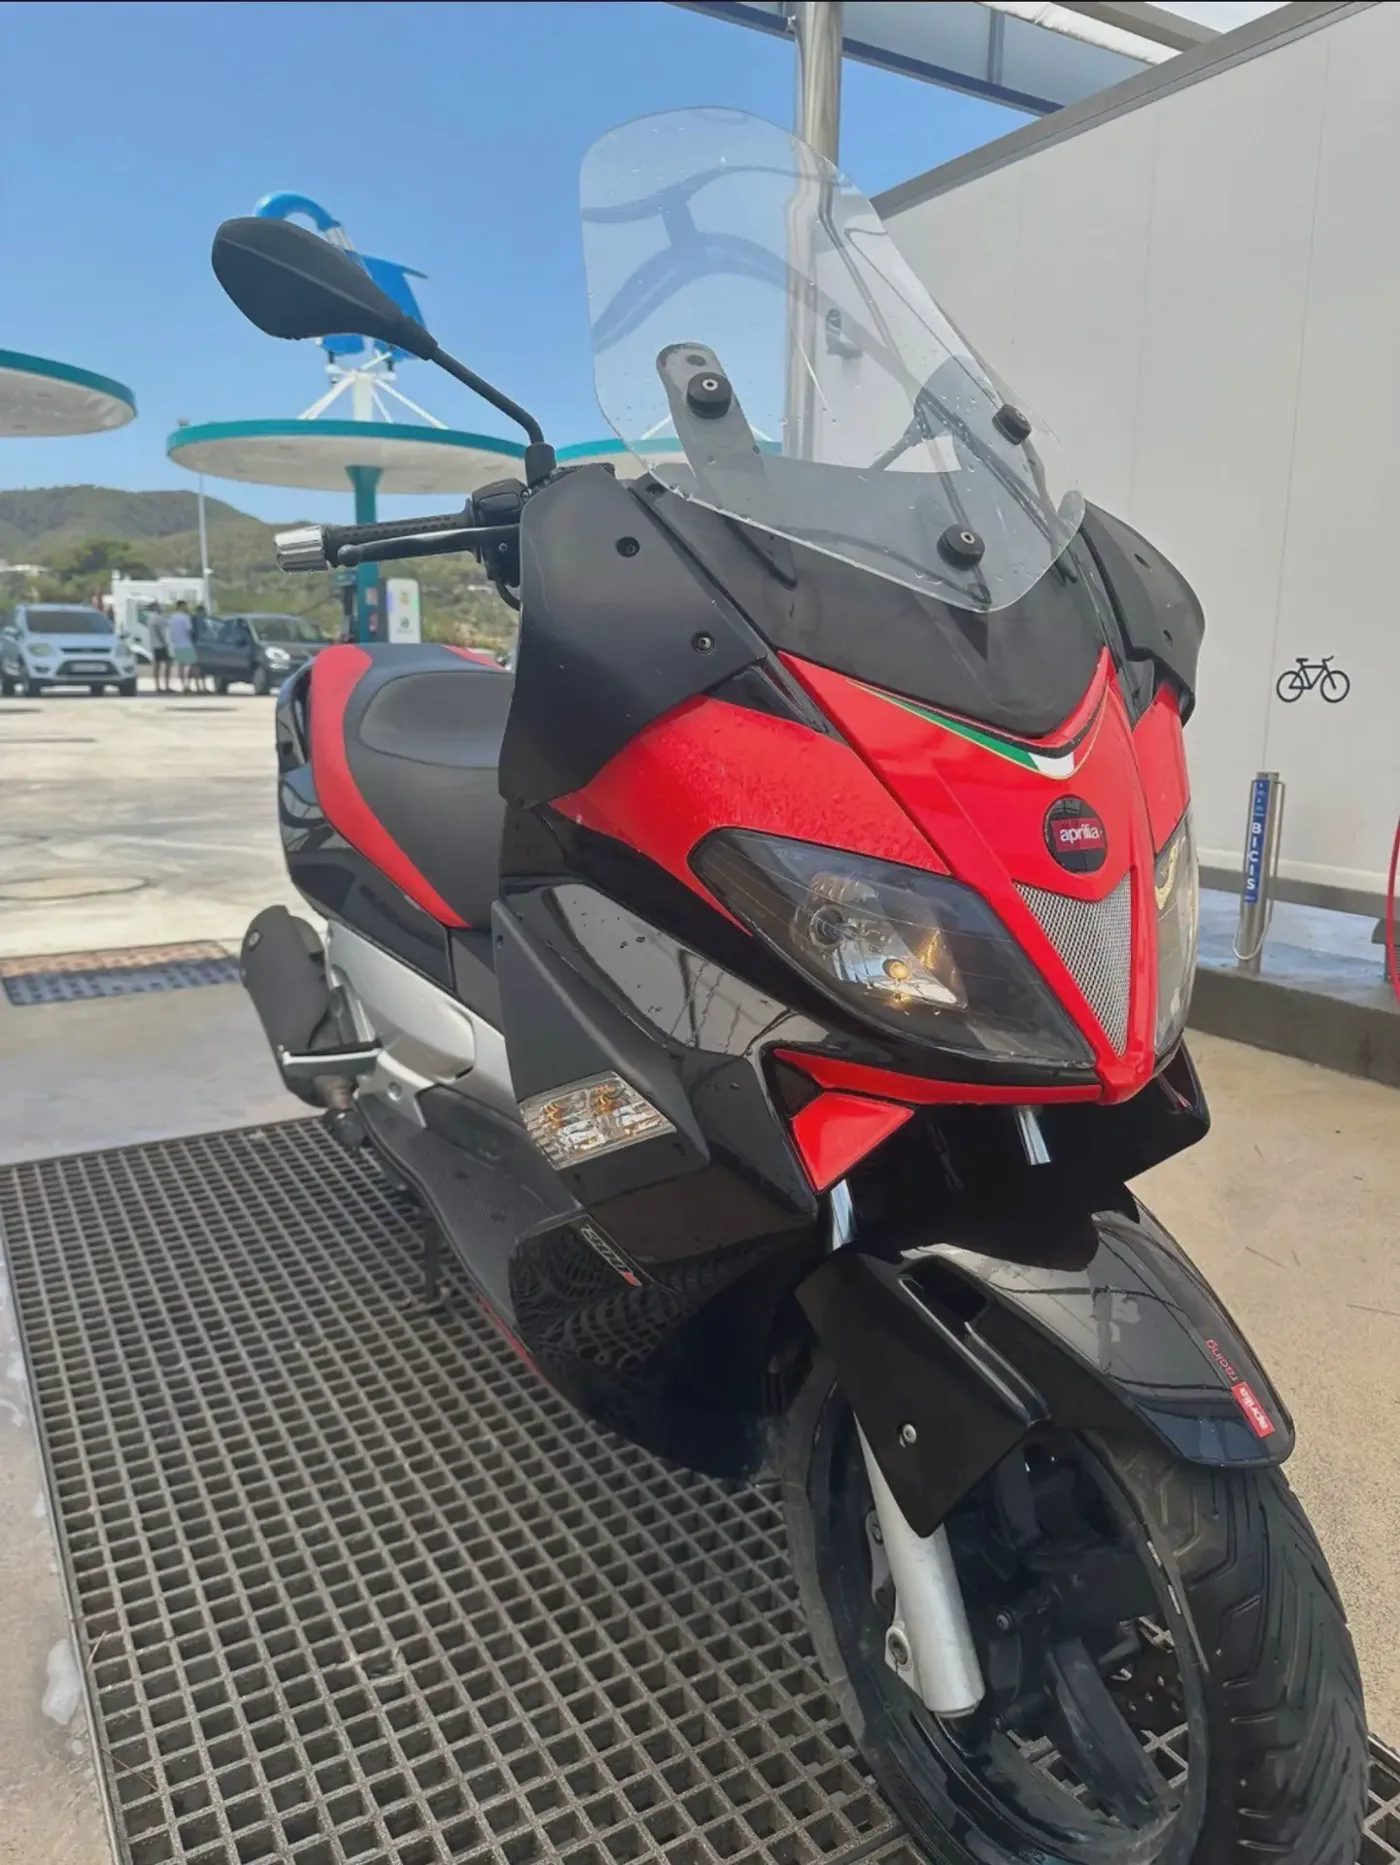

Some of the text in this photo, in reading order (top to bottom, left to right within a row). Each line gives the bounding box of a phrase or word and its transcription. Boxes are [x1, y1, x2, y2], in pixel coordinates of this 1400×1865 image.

[1060, 823, 1099, 844] aprilia
[1246, 822, 1262, 890] BICIS
[1206, 1339, 1269, 1430] aprilia racing
